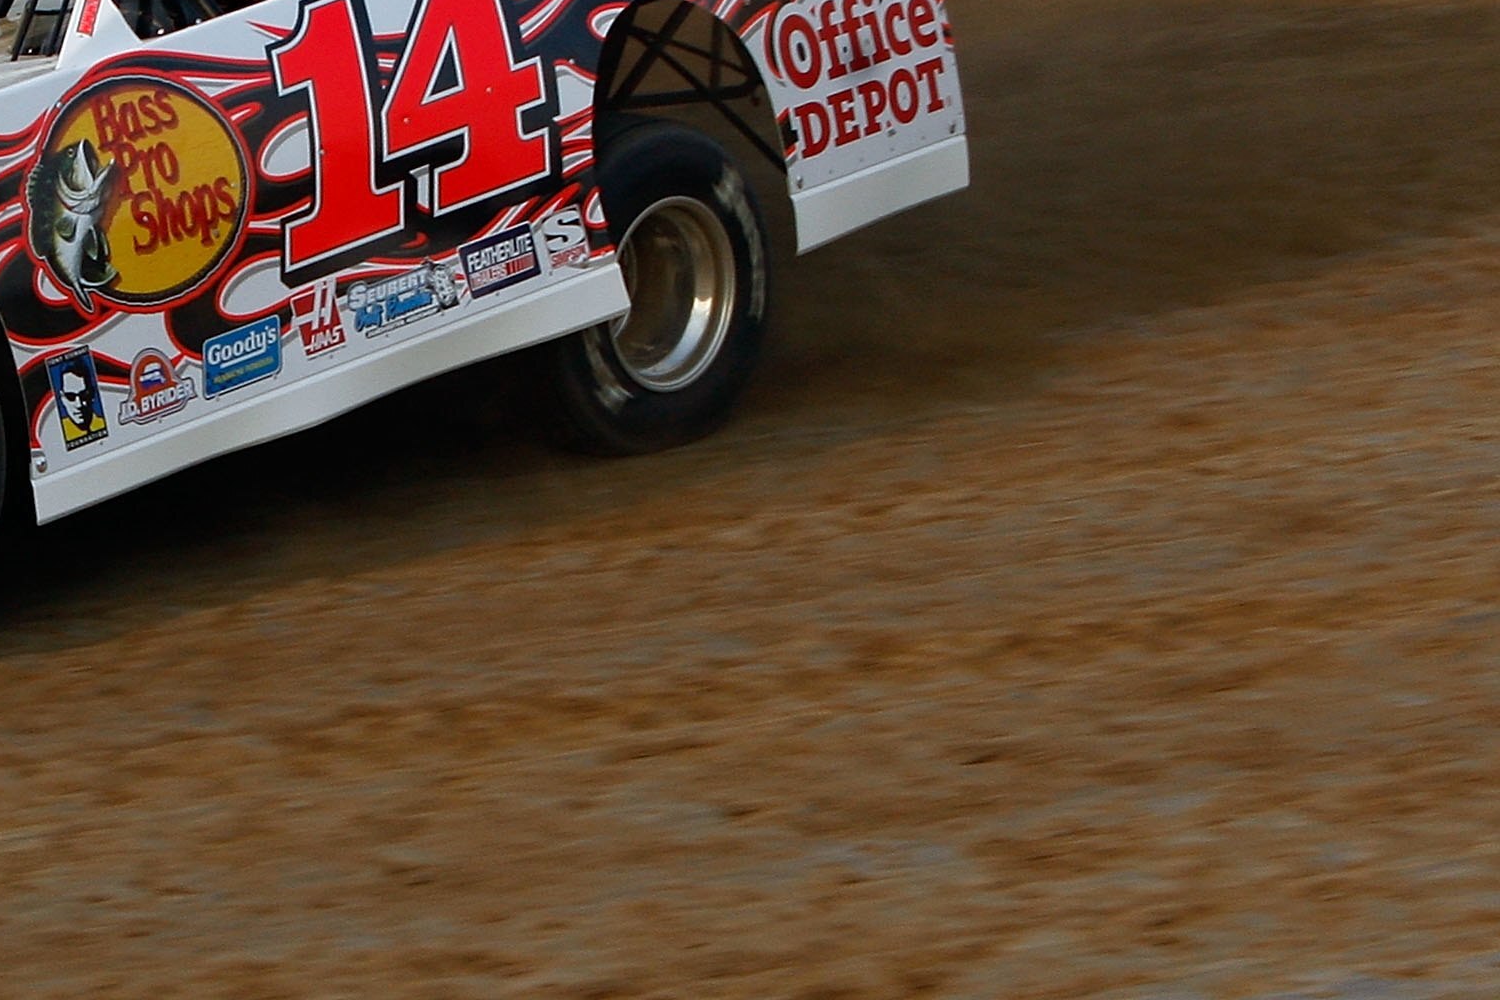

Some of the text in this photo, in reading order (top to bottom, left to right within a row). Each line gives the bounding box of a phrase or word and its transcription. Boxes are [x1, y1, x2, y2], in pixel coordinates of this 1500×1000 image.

[91, 90, 180, 153] Bass
[795, 57, 946, 159] DEPOT
[112, 141, 181, 200] Pro
[131, 176, 238, 257] Shops
[466, 232, 534, 274] FEATHERLITE
[349, 269, 428, 311] SEUBERT
[207, 326, 278, 368] Goody's
[141, 380, 194, 414] BYRIDER
